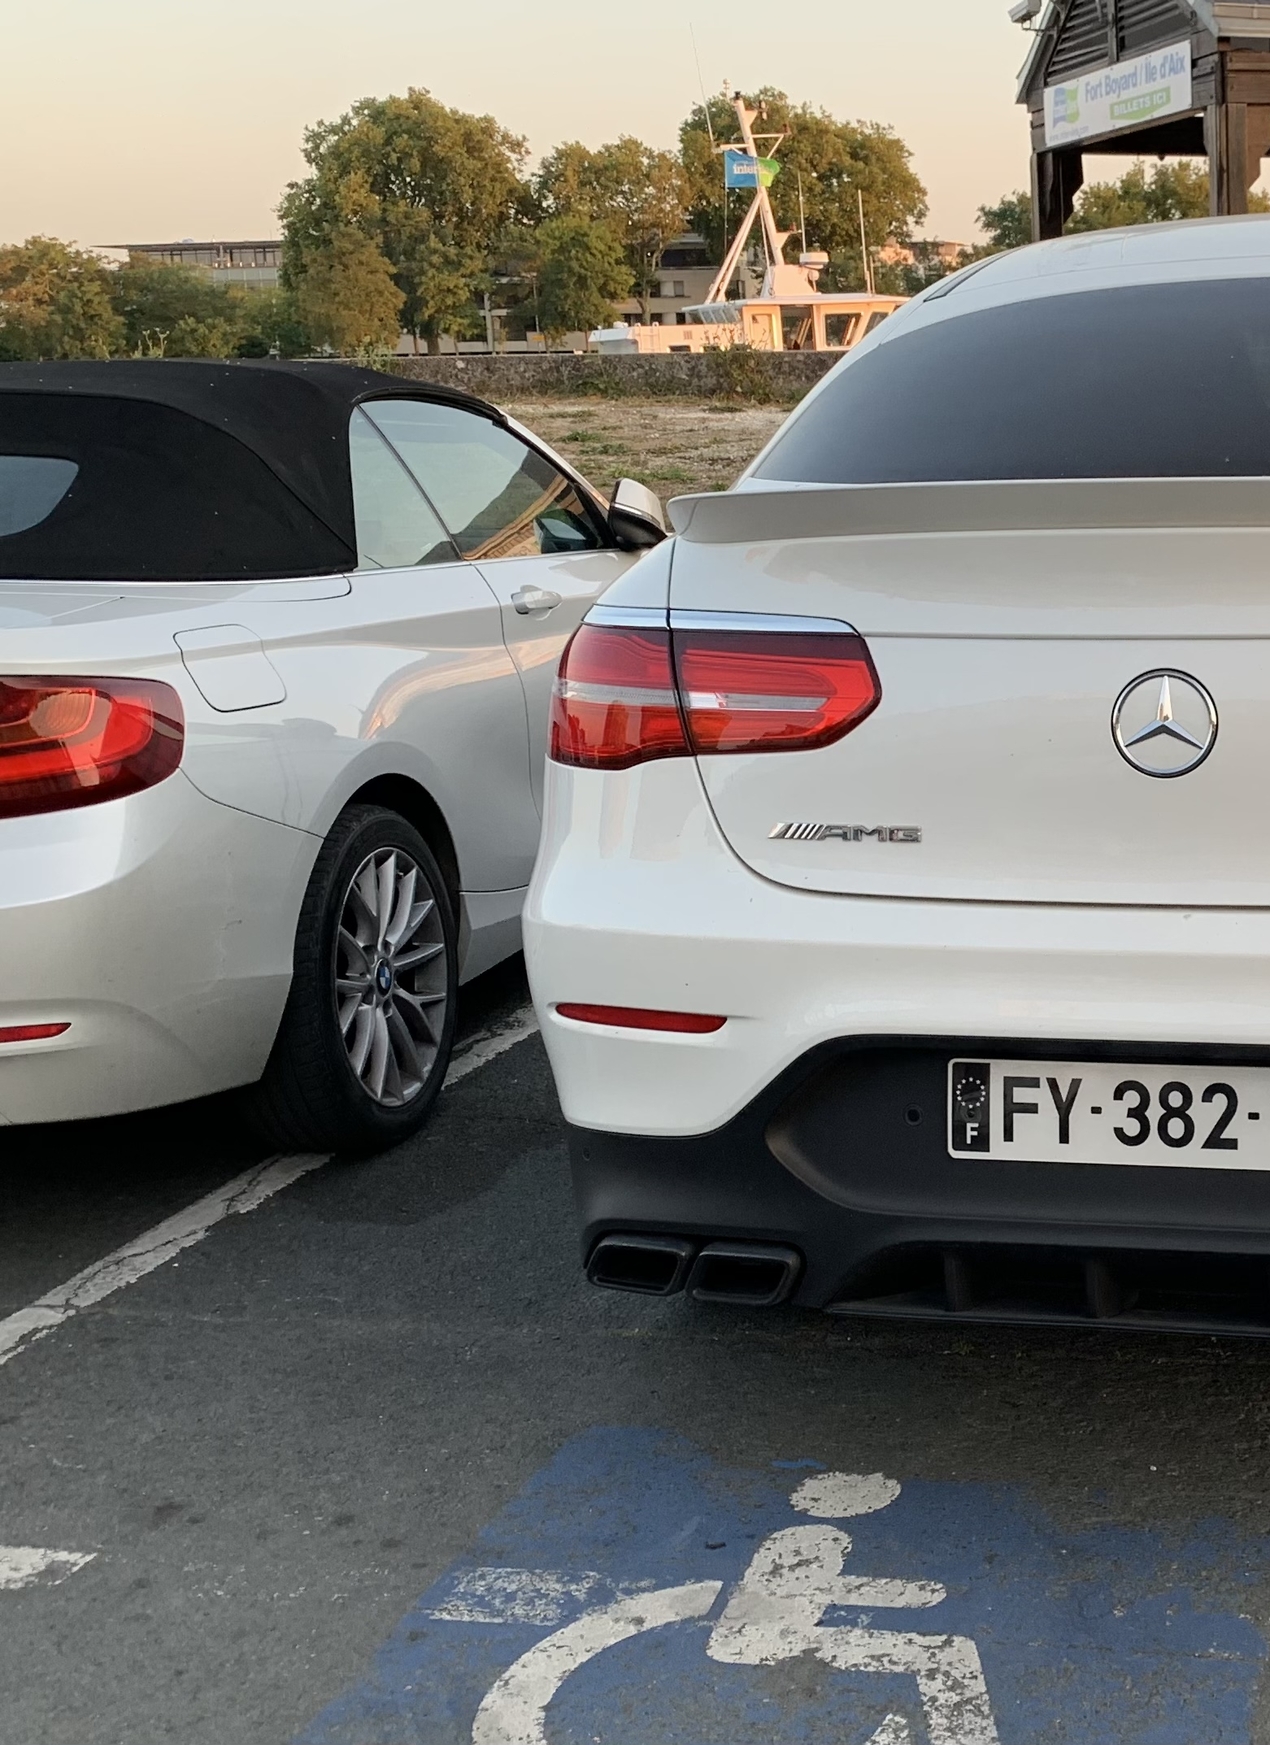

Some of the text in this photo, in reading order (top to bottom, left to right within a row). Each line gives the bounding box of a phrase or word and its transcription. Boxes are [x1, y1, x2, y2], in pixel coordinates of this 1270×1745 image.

[1085, 80, 1103, 103] Fort
[1104, 65, 1138, 99] Boyard
[1113, 92, 1167, 117] BILLETS ICI
[820, 824, 922, 842] AMG
[966, 1122, 979, 1144] F
